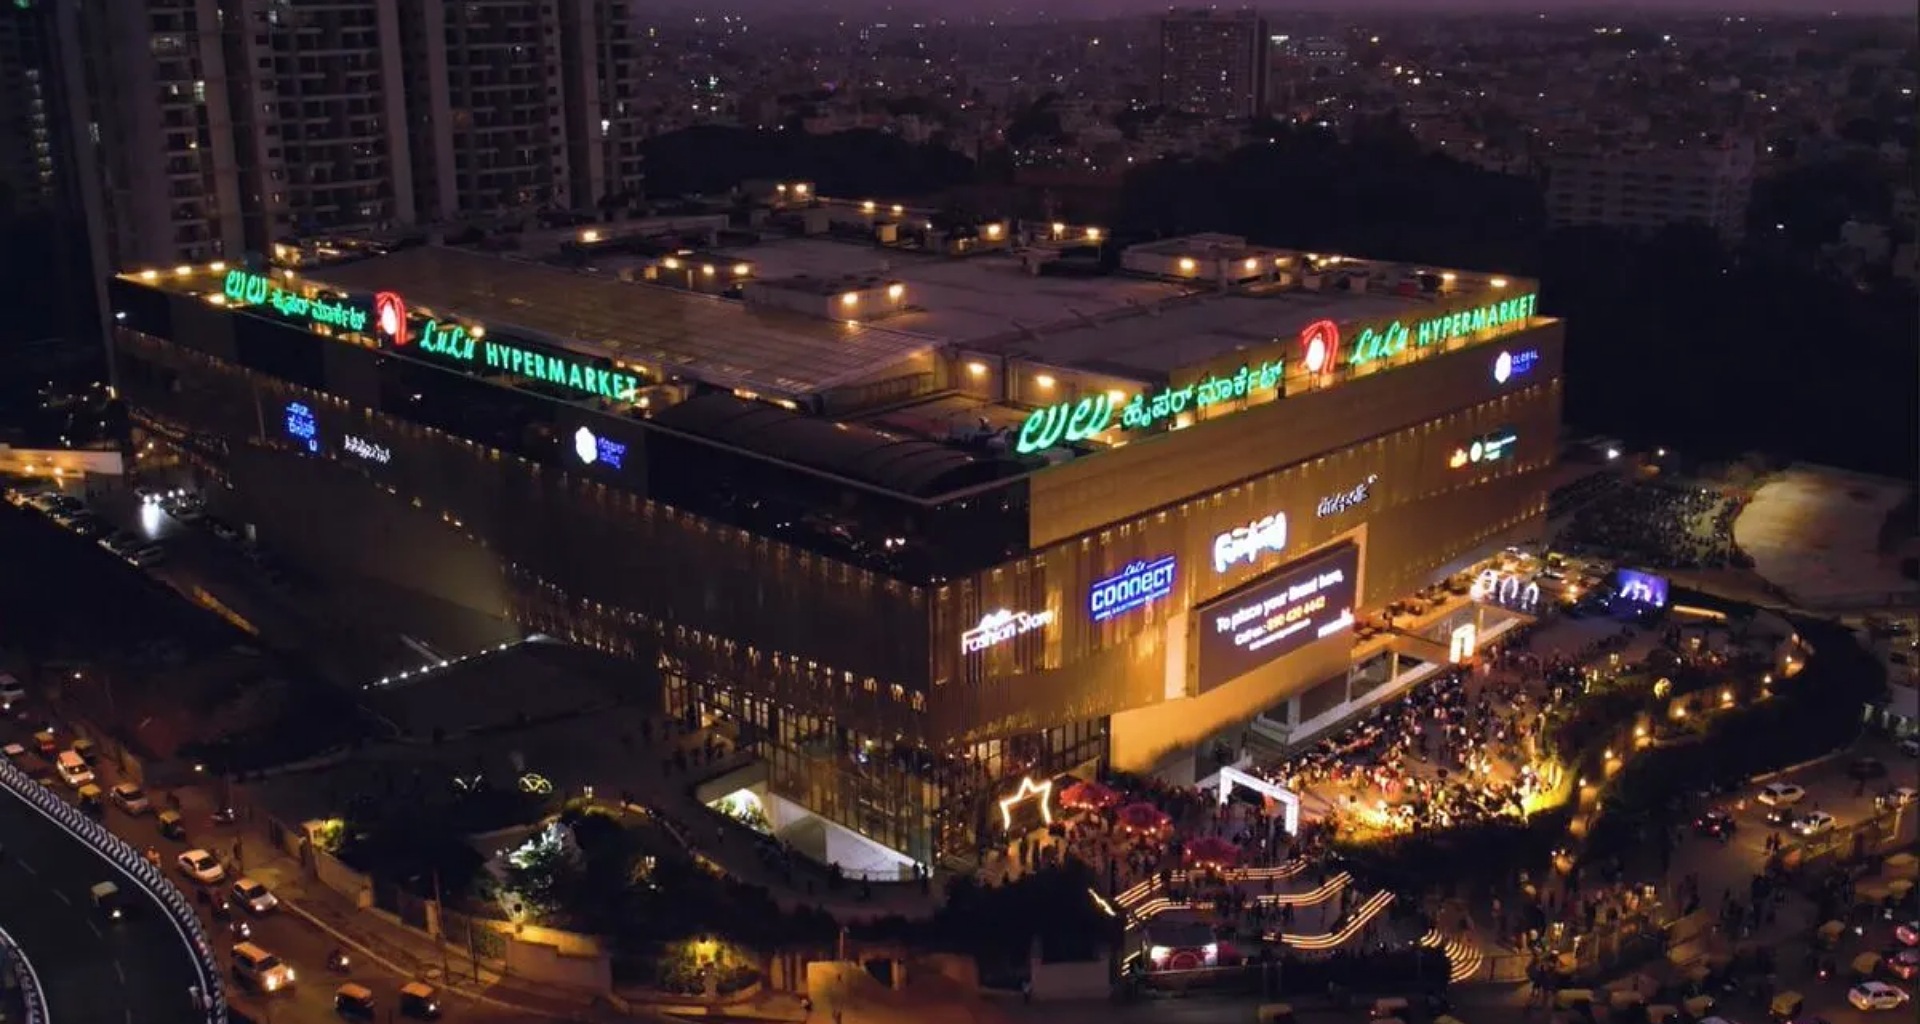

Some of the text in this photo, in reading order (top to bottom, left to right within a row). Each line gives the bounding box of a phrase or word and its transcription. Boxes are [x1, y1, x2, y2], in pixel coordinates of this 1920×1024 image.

[419, 319, 638, 402] LuLu HYPERMARKET
[1350, 294, 1536, 365] LuLu HYPERMARKET
[1216, 616, 1231, 634] To
